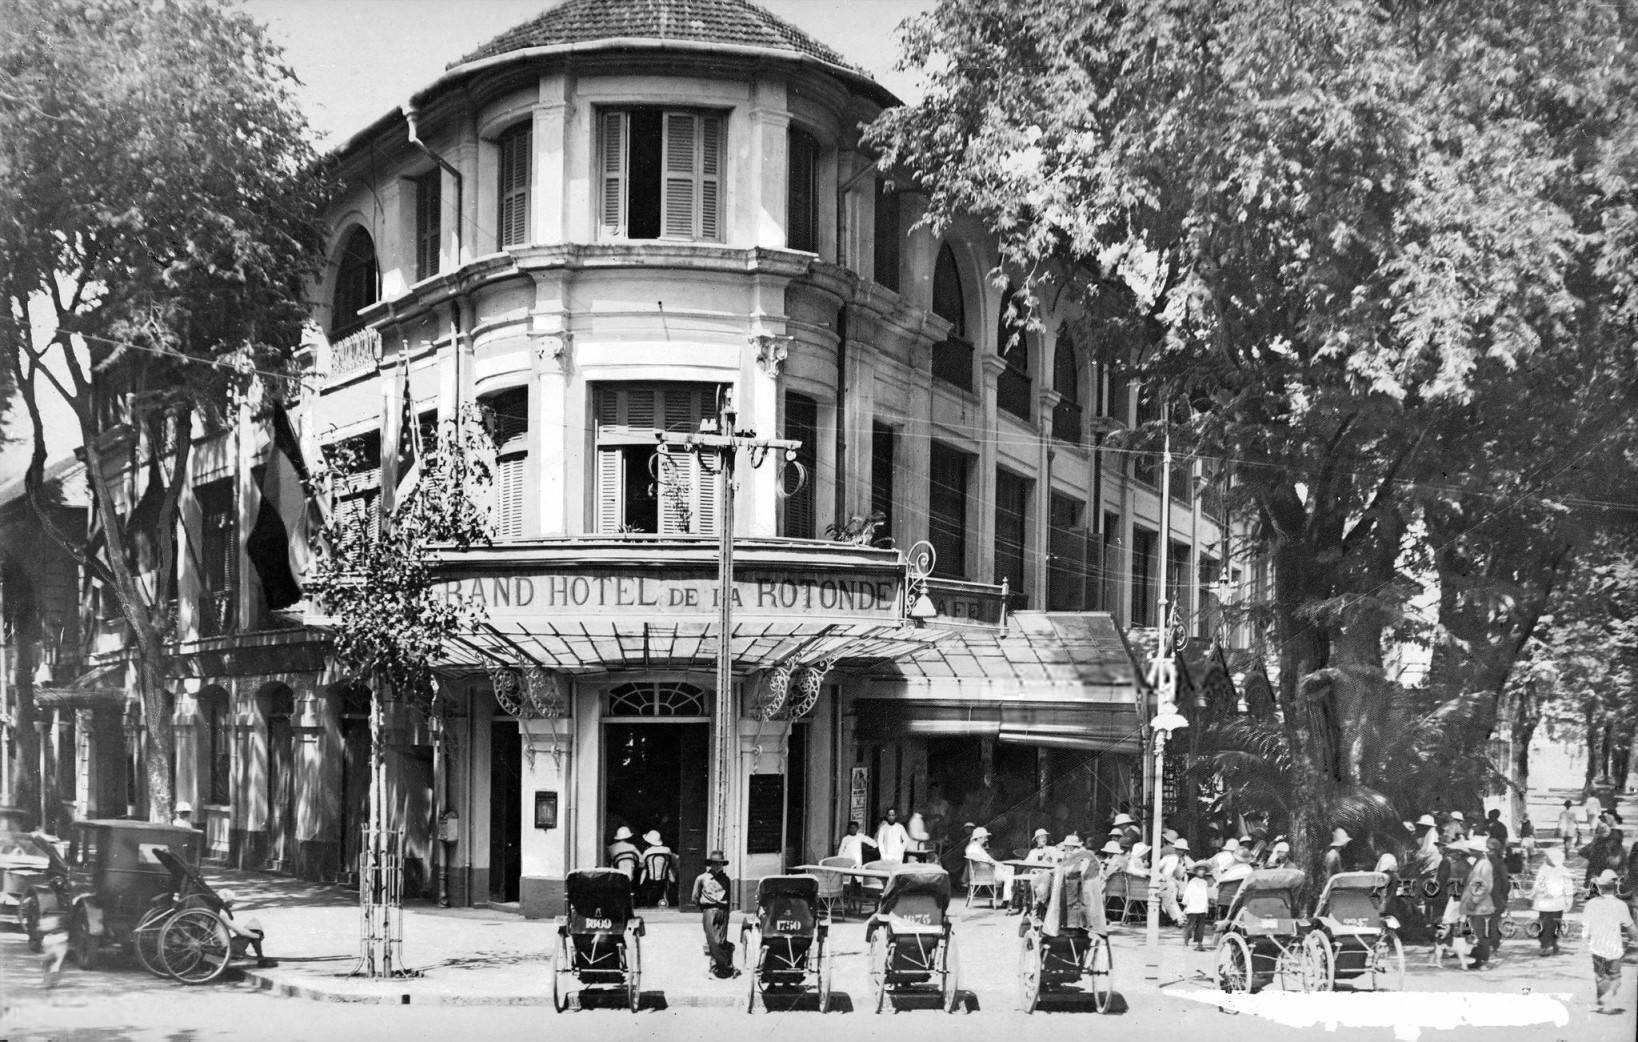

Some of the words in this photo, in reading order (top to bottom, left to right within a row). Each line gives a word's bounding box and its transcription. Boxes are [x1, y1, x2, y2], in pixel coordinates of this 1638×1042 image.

[434, 576, 534, 607] RAND
[550, 576, 658, 607] HOTEL
[669, 587, 698, 607] DE
[755, 577, 894, 611] ROTONDE
[936, 599, 980, 620] AFE
[776, 920, 802, 931] 1750
